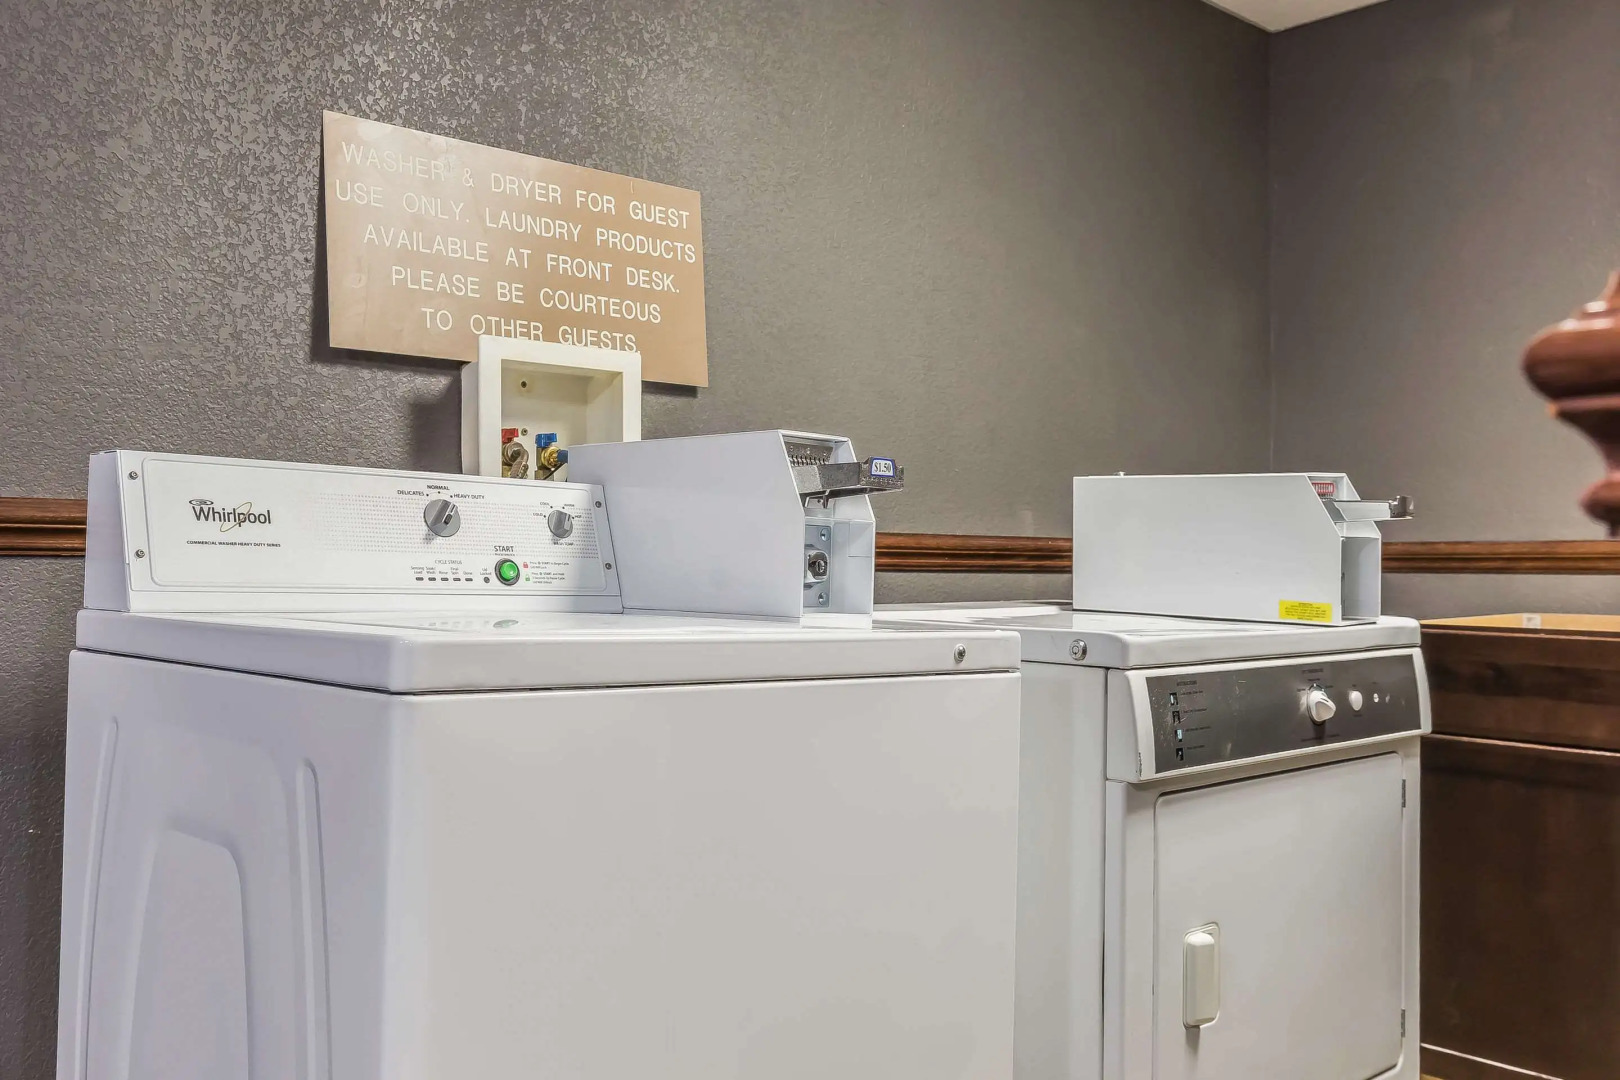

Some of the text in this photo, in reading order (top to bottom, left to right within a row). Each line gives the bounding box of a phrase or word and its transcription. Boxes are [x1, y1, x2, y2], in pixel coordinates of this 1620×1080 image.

[342, 141, 690, 229] WASHER & DRYER FOR GUEST
[335, 178, 696, 263] USE ONLY. LAUNDRY PRODUCTS
[363, 223, 680, 293] AVAILABLE AT FRONT DESK.
[391, 265, 661, 324] PLEASE BE COURTEOUS
[421, 307, 453, 331] TO
[470, 314, 543, 342] OTHER
[874, 461, 892, 474] $1.50
[397, 489, 425, 497] DELICATES
[192, 506, 271, 527] Whirlpool
[493, 545, 514, 553] START
